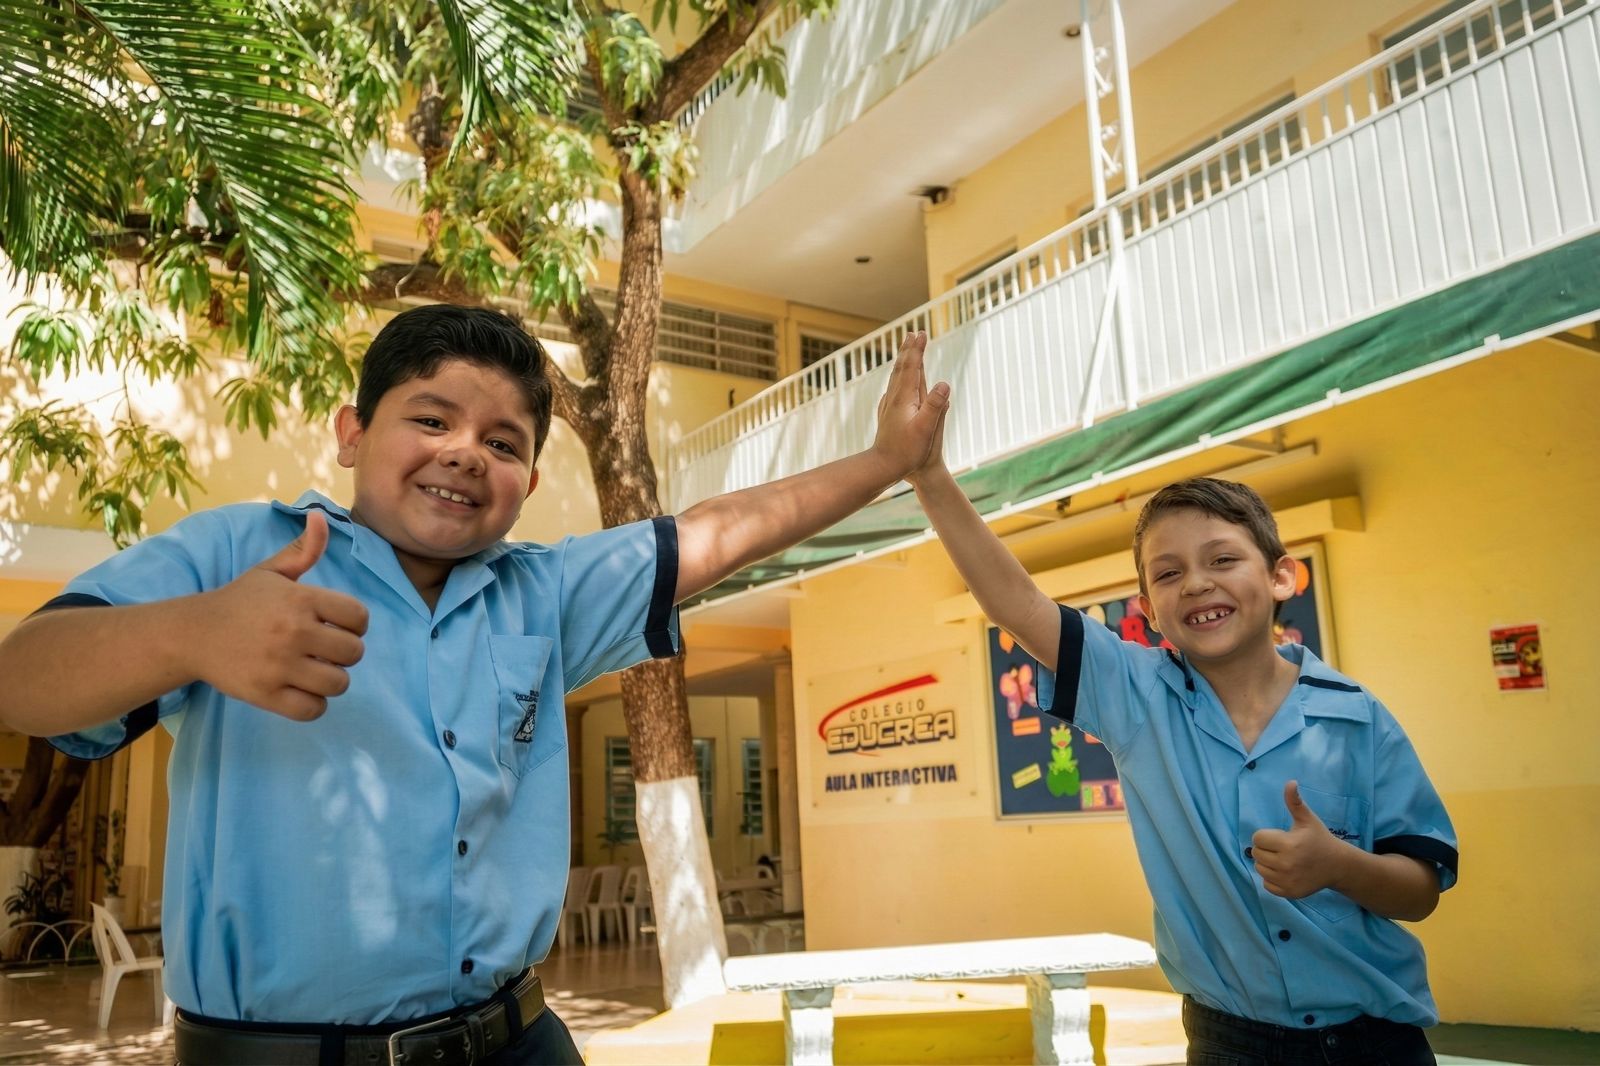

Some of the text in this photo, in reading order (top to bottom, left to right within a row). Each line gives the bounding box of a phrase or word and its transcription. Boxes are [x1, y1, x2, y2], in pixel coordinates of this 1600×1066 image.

[850, 699, 925, 722] COLEGIO
[826, 710, 956, 754] EDUCREA
[825, 764, 957, 792] AULA INTERACTIVA
